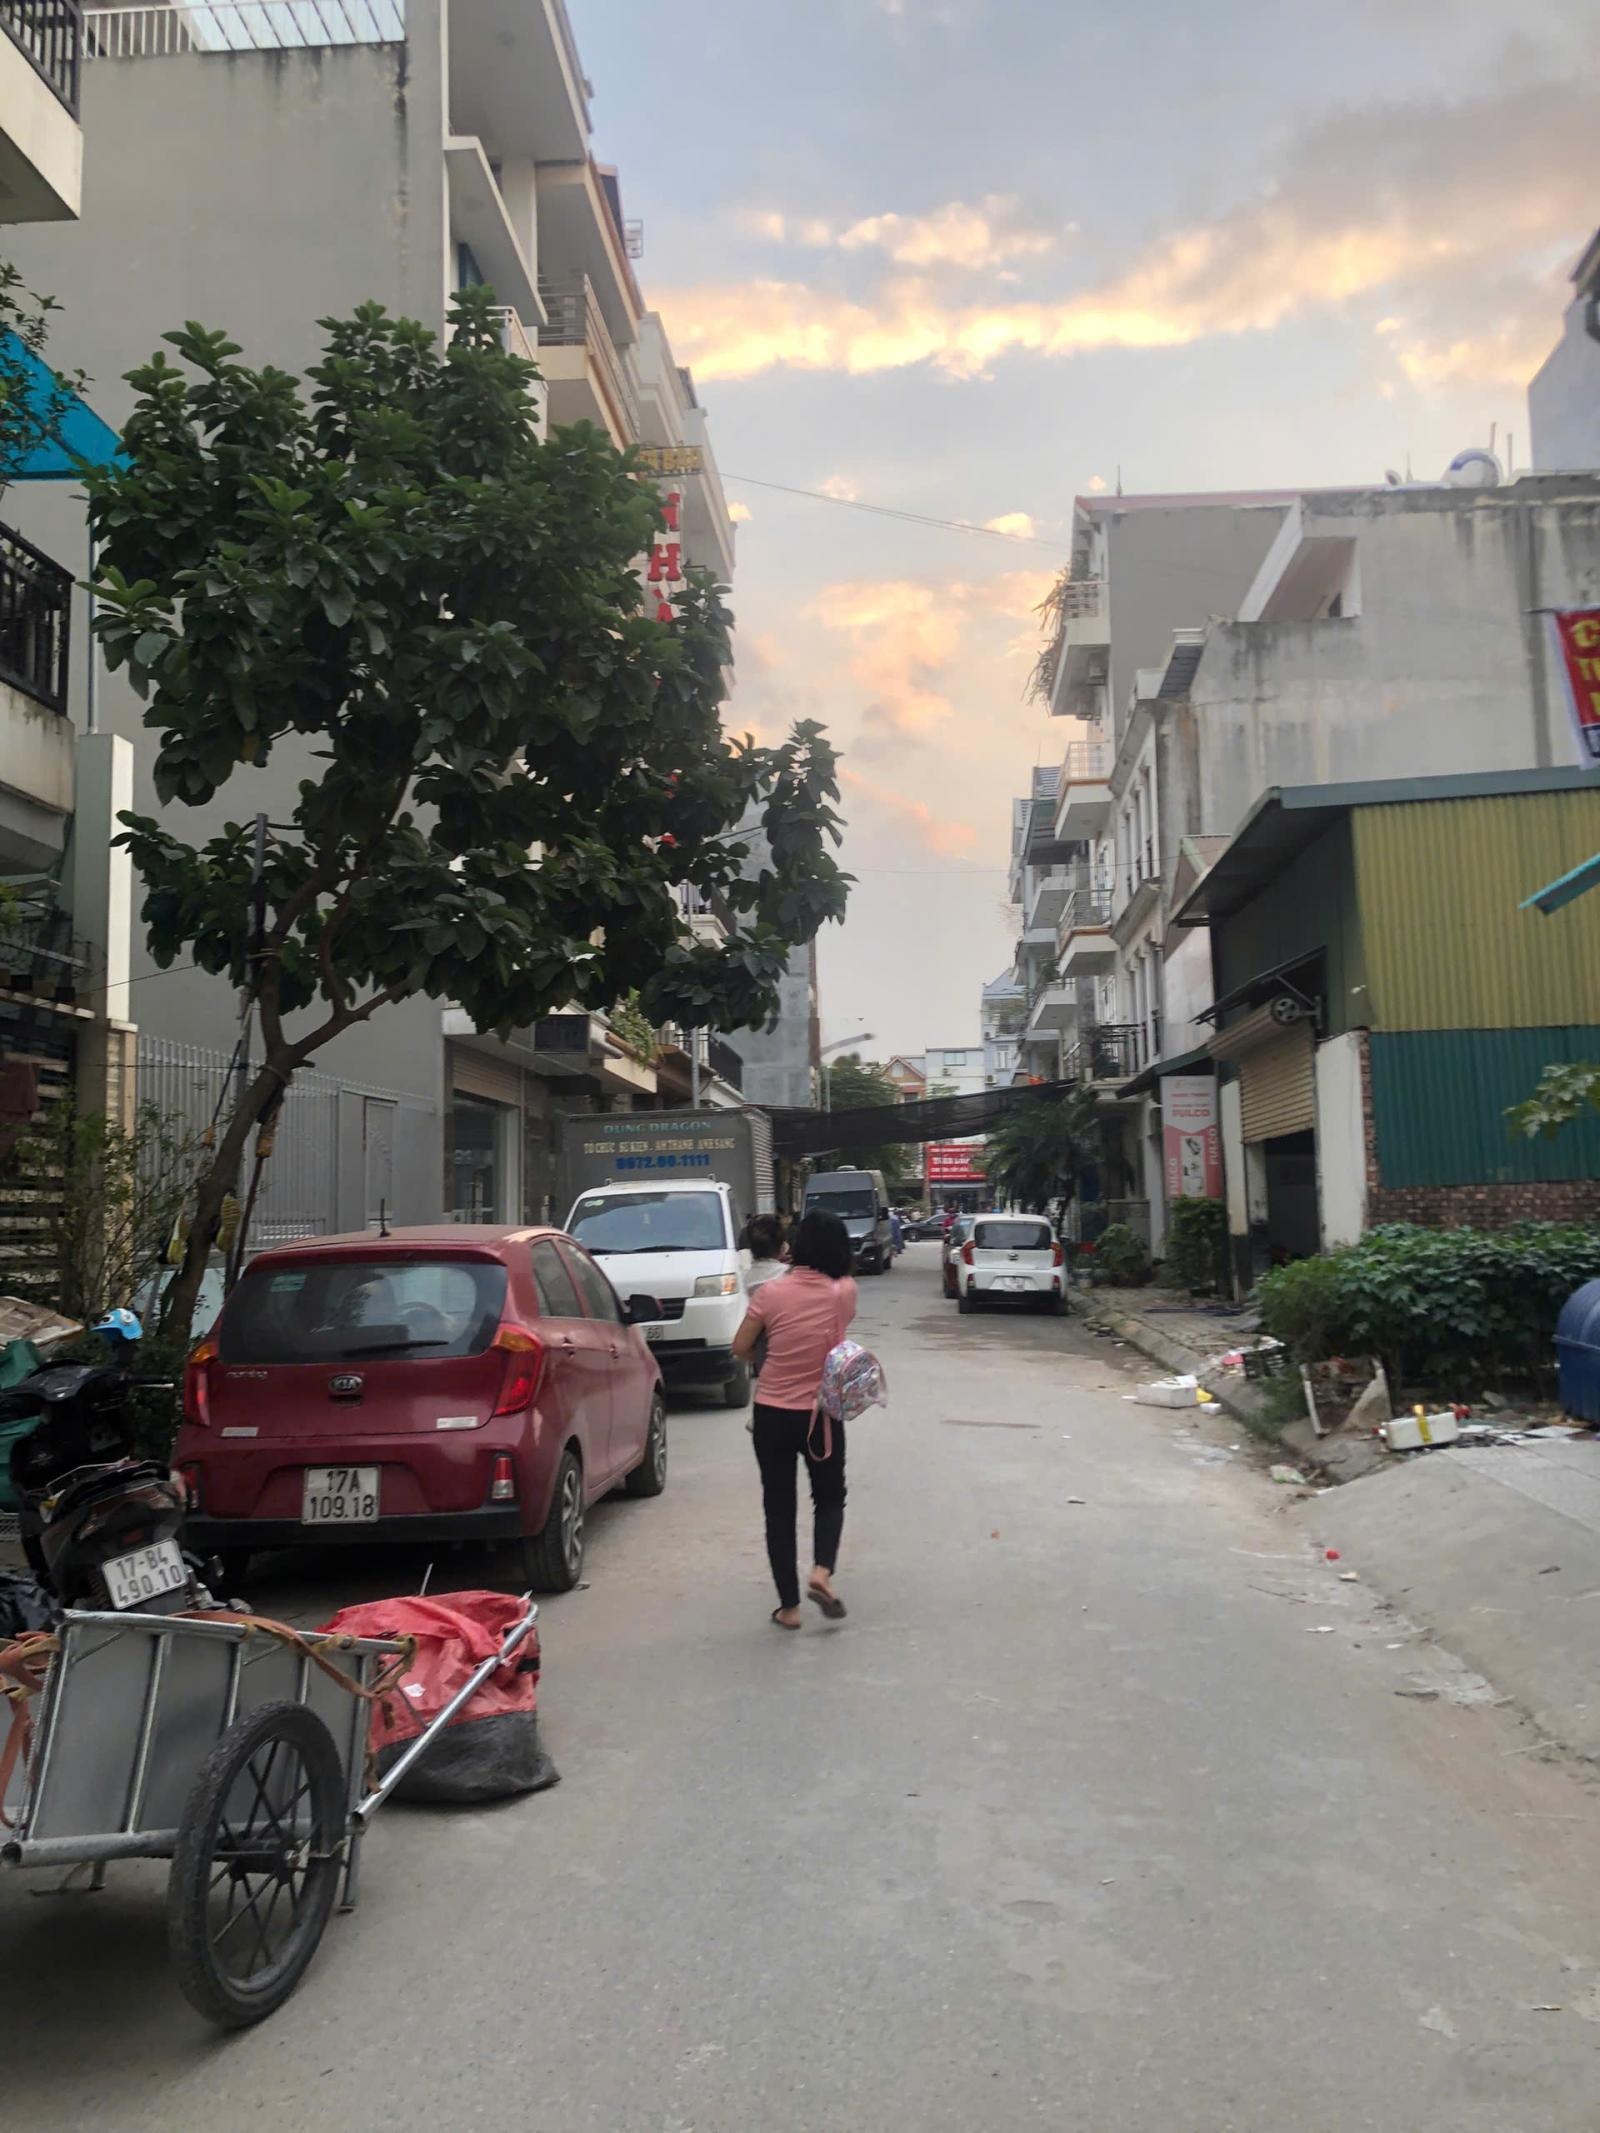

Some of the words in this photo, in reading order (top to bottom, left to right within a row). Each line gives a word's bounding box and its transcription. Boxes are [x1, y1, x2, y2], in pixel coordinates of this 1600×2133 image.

[649, 1120, 712, 1132] DRAGON
[332, 1377, 359, 1391] KIA
[326, 1470, 361, 1492] 17A
[309, 1495, 376, 1519] 109.18
[116, 1547, 169, 1580] 17-B4
[117, 1564, 182, 1604] 490.10
